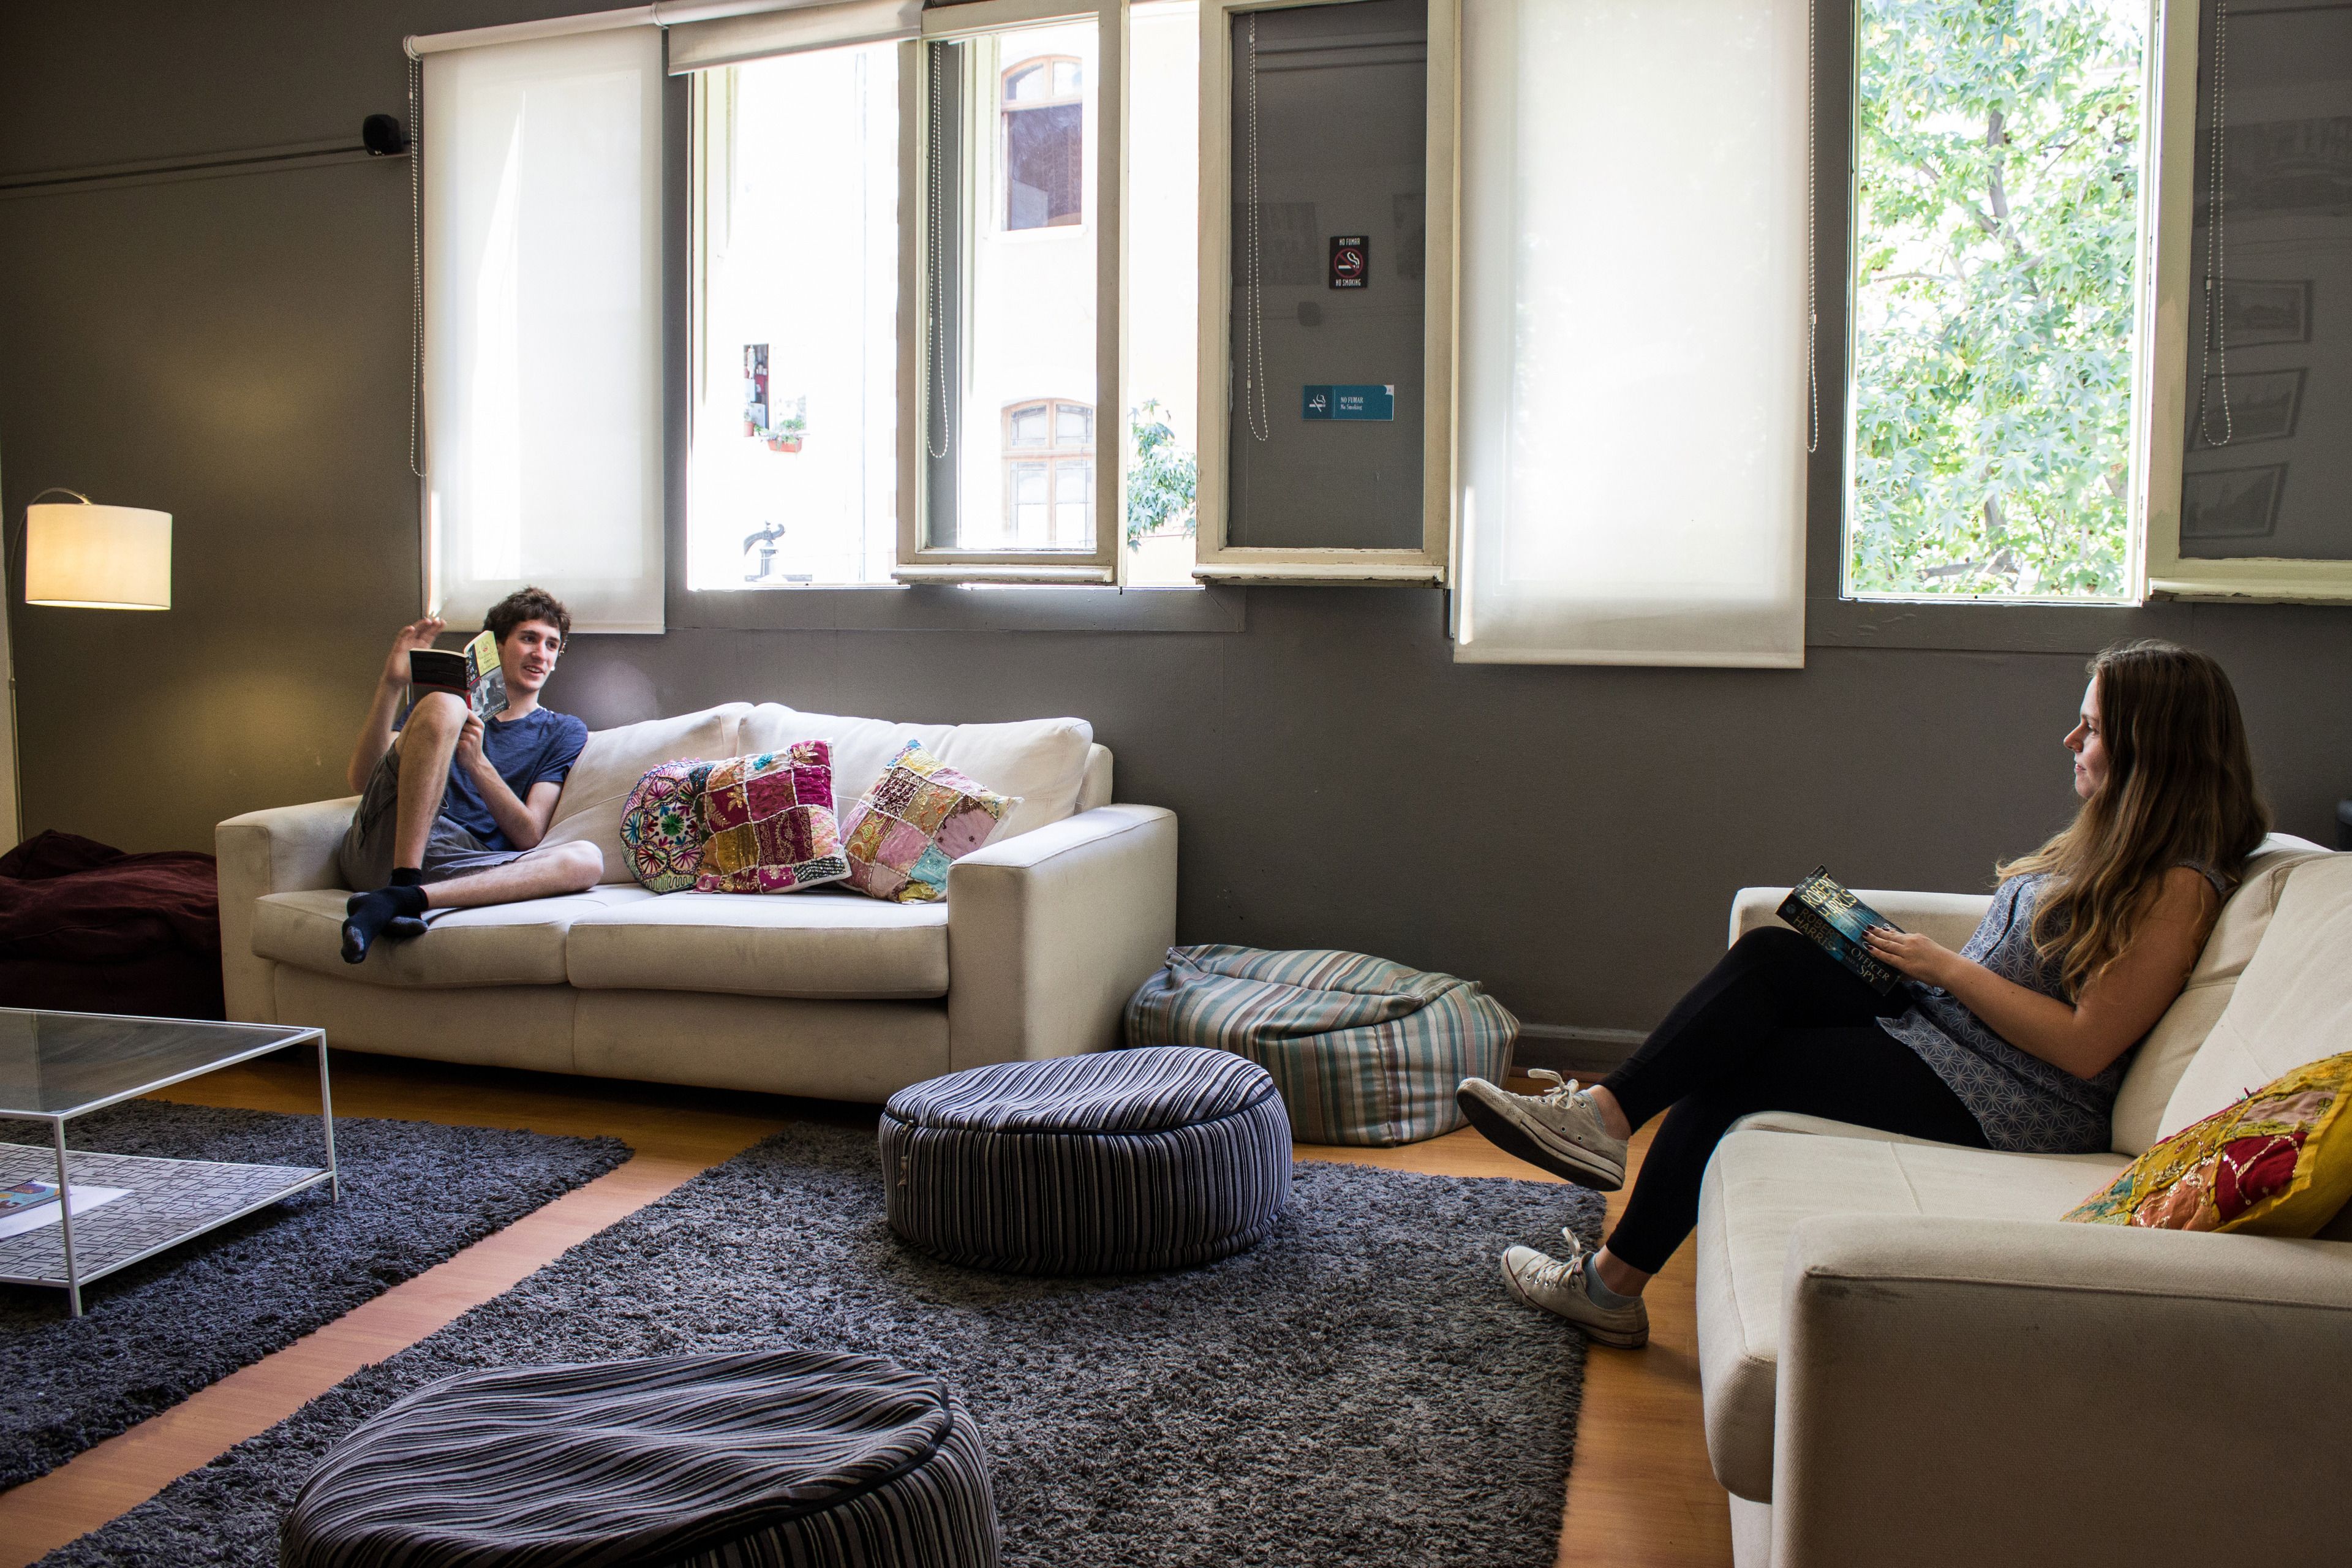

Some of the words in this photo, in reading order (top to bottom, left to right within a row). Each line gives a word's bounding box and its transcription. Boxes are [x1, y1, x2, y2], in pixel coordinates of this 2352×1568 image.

[1800, 873, 1839, 909] ROBERT
[1818, 889, 1857, 923] HARRIS
[1792, 916, 1836, 951] HARRIS
[1800, 908, 1842, 940] ROBERT
[1851, 947, 1890, 981] OFFICER
[1857, 965, 1878, 983] SPY
